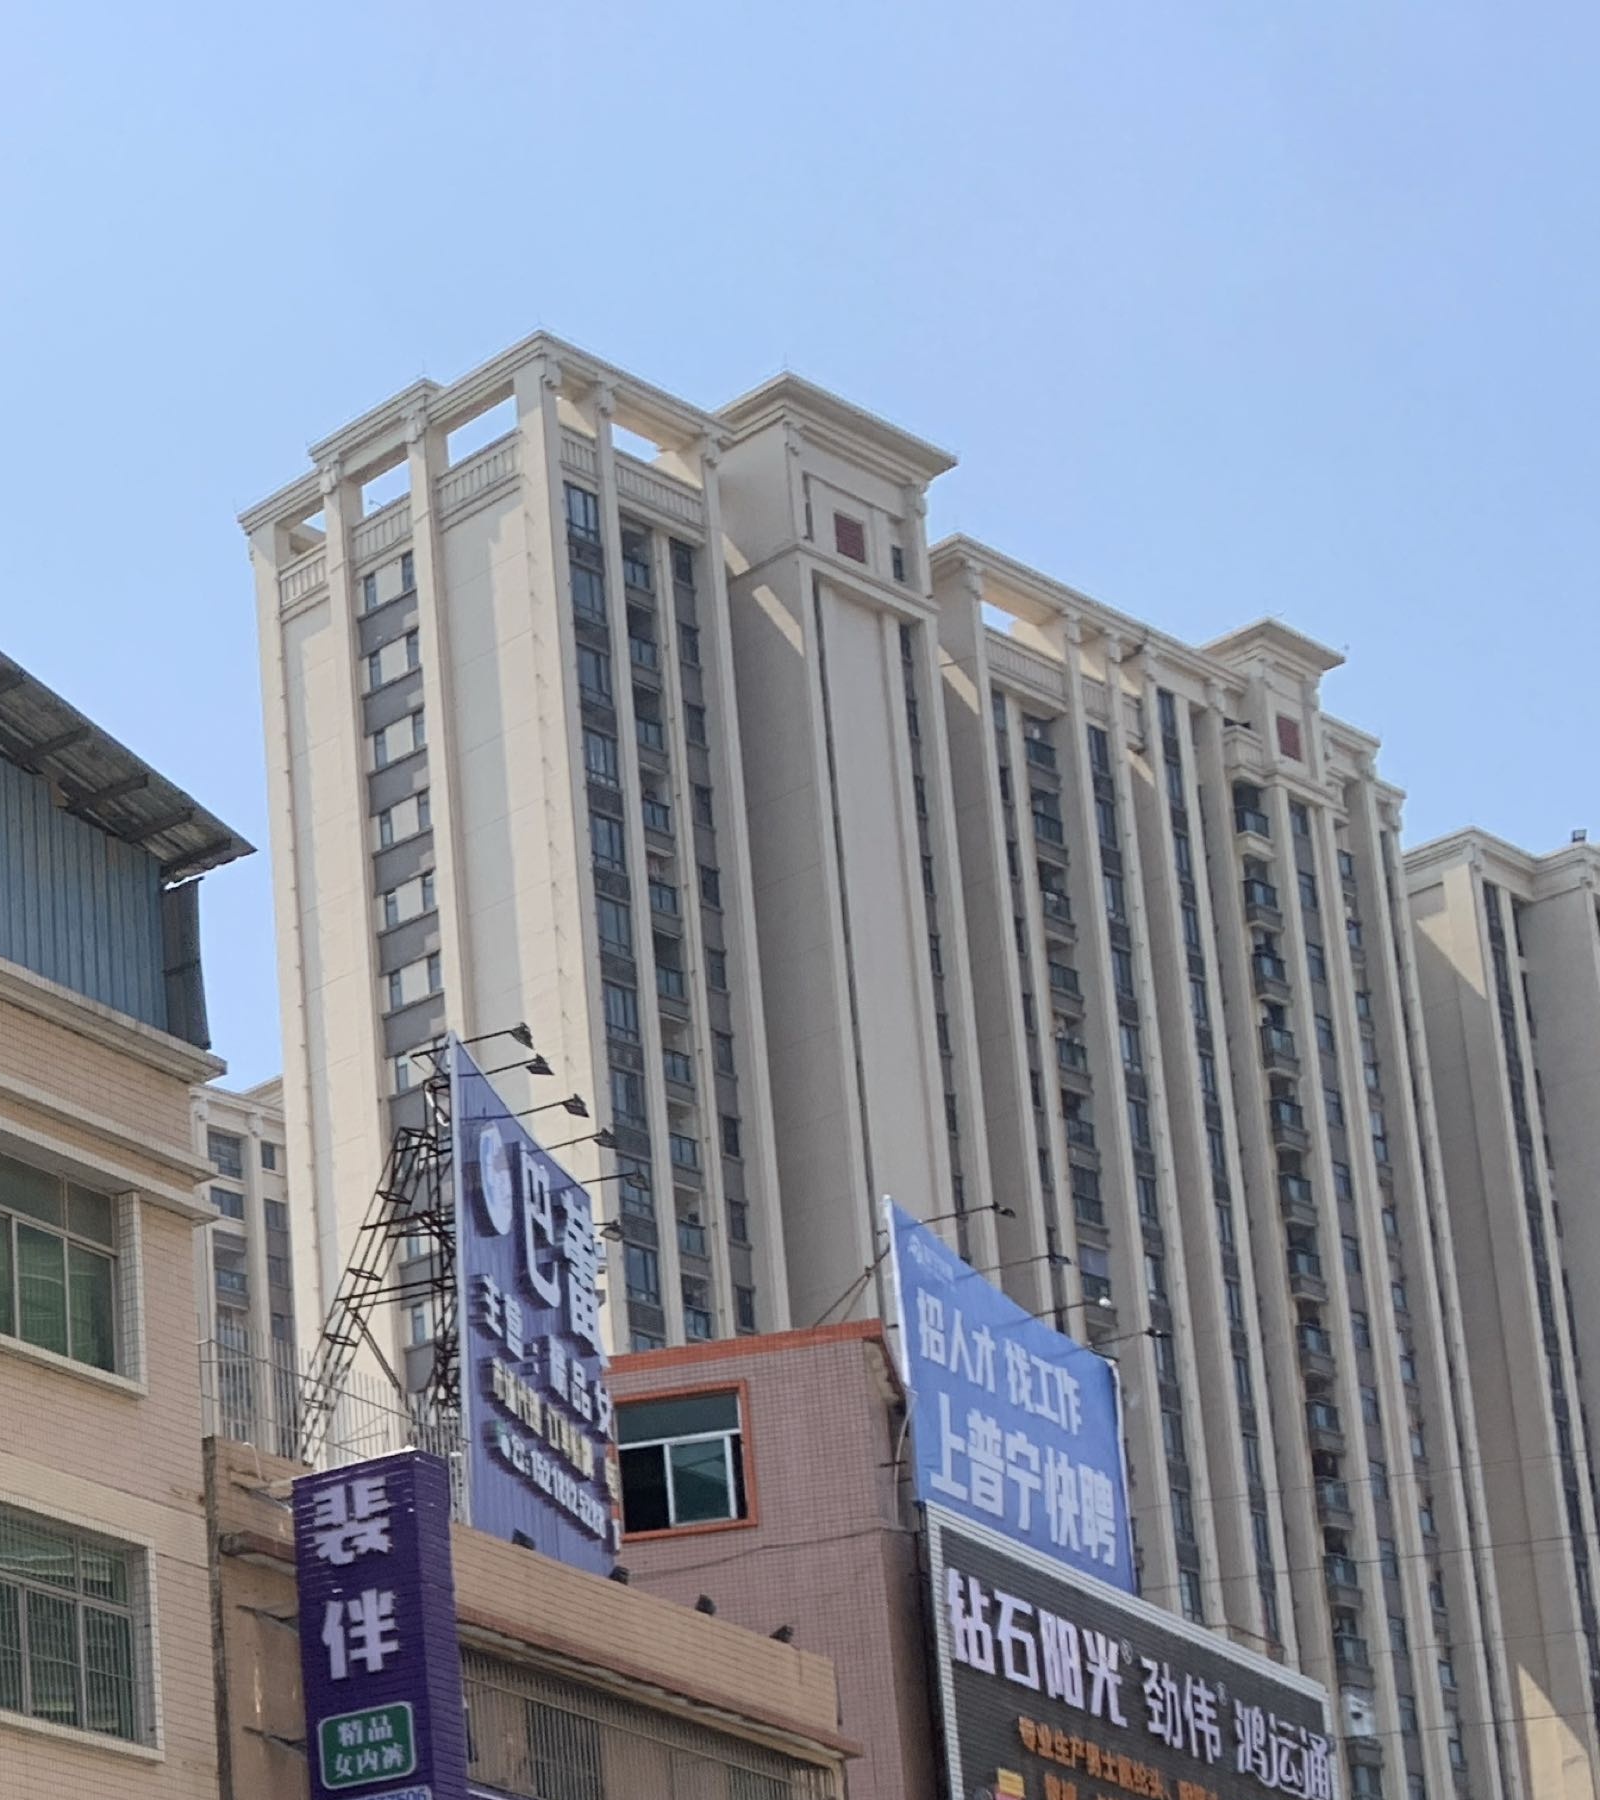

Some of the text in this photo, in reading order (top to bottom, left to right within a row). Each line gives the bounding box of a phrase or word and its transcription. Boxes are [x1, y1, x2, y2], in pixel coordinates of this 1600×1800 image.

[916, 1288, 1082, 1436] 招人才 找工作
[930, 1392, 1116, 1567] 上普宁快聘
[333, 1743, 406, 1780] 女内裤
[337, 1714, 394, 1748] 精品
